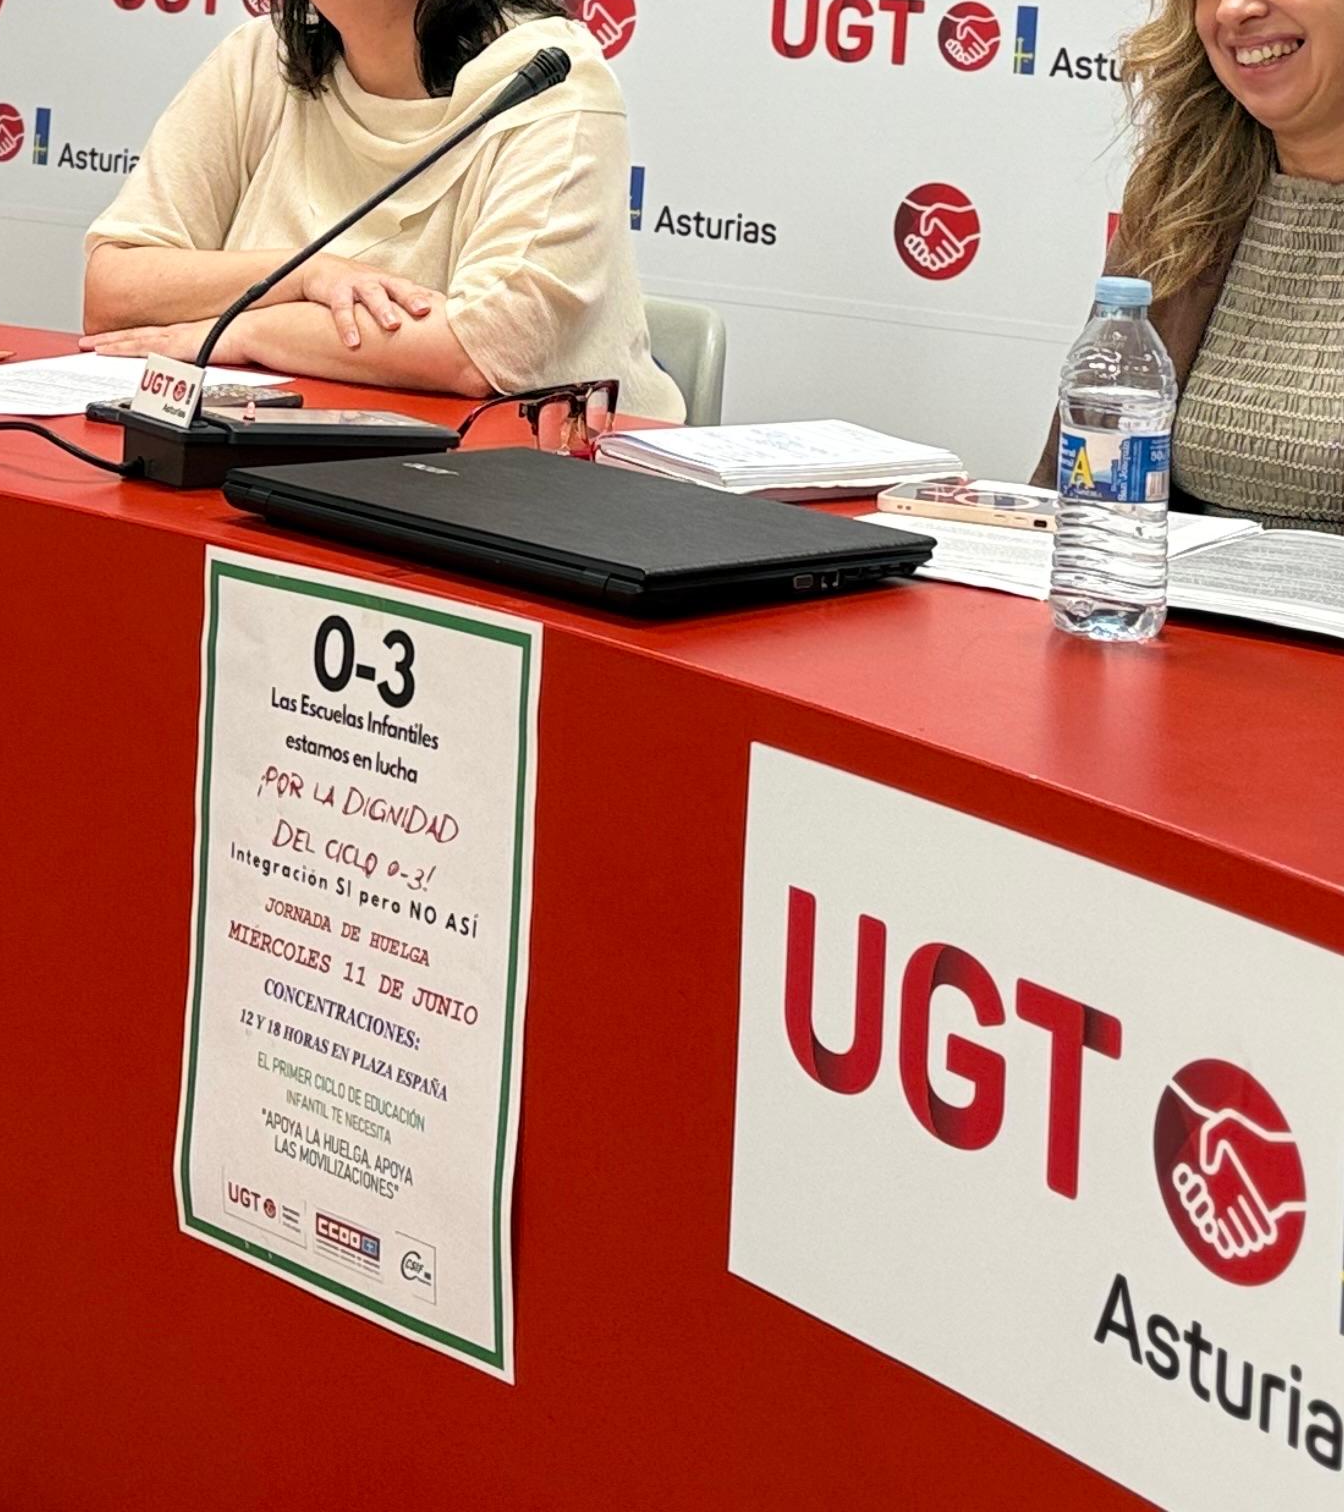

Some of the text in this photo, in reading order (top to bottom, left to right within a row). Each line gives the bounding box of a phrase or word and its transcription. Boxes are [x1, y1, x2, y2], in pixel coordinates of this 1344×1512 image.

[655, 206, 776, 245] Asturias
[141, 368, 174, 397] UGT
[314, 615, 416, 708] 0-3
[272, 687, 439, 750] Las Escuelas Infantiles
[286, 735, 417, 783] estamos en lucha
[314, 783, 334, 807] LA
[342, 787, 459, 843] DIGNIDAD
[272, 819, 315, 853] DEL
[325, 839, 378, 876] CICLO
[231, 842, 327, 890] Integración
[359, 891, 400, 914] pero
[410, 900, 436, 924] NO
[265, 897, 429, 967] JORNADA DE HUELGA
[228, 920, 478, 1025] MIÉRCOLES 11 DE JUNIO
[264, 978, 420, 1050] CONCENTRACIONES:
[785, 886, 1122, 1199] UGT
[240, 1009, 447, 1101] 12 Y 18 HORAS EN PLAZA ESPAÑA
[258, 1051, 425, 1132] EL PRIMER CICLO DE EDUCACIÓN
[287, 1089, 391, 1144] INFANTIL TE NECESITA
[275, 1137, 296, 1159] LAS
[306, 1127, 320, 1147] LA
[374, 1155, 413, 1186] APOYA
[228, 1181, 261, 1212] UGT
